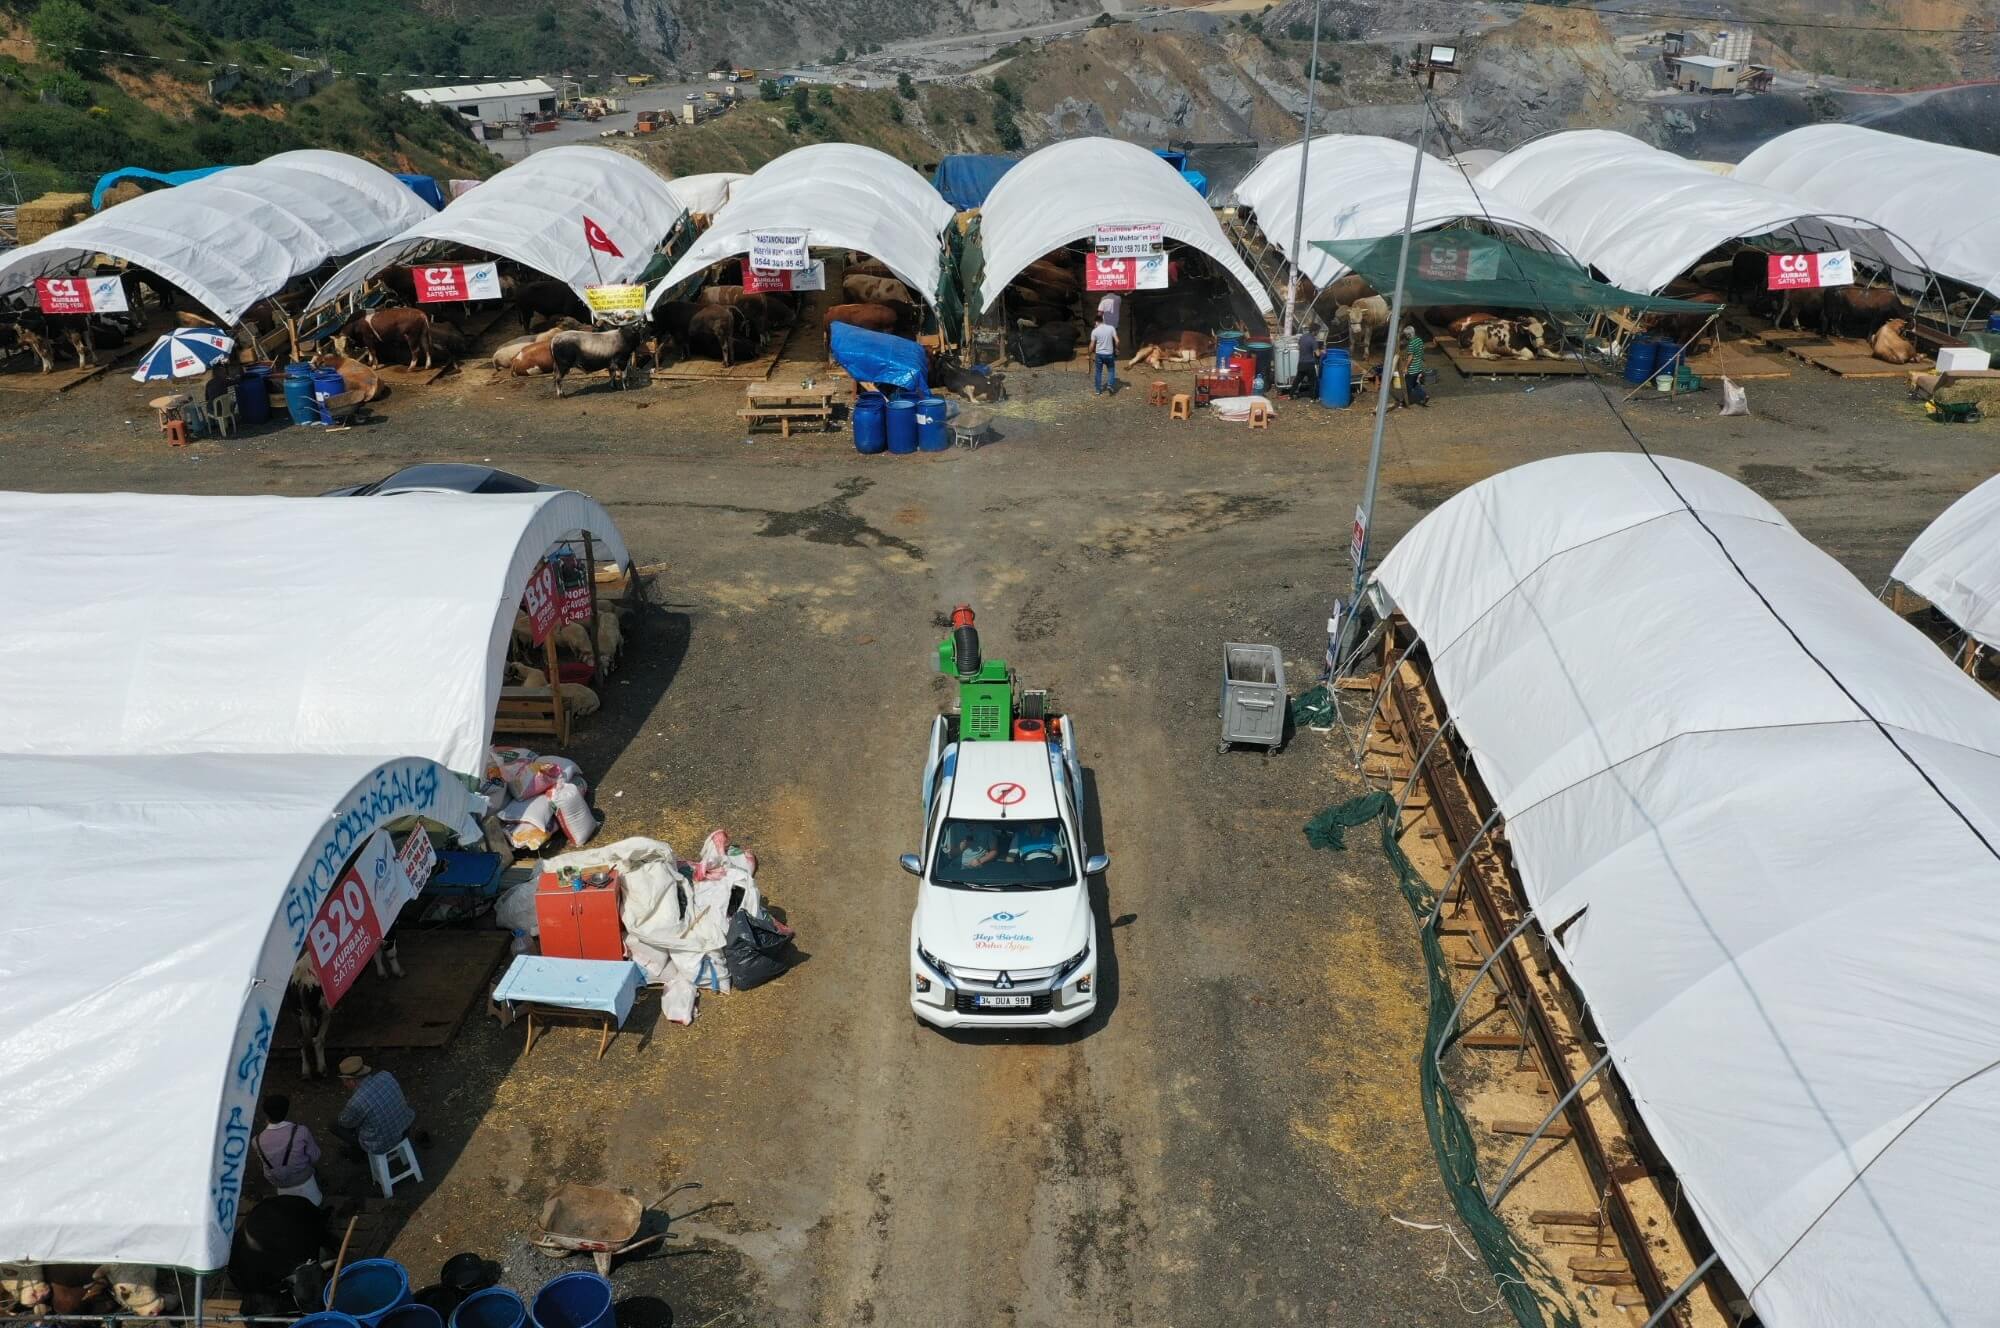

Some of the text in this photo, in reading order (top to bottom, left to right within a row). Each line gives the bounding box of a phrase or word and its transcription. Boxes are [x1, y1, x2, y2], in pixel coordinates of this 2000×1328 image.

[1096, 258, 1126, 272] C4
[1431, 248, 1458, 264] C5
[1780, 255, 1808, 272] C6
[424, 268, 454, 284] C2
[46, 280, 80, 296] C1
[526, 568, 552, 616] B19
[310, 880, 365, 968] B20
[332, 926, 366, 971] KURBAN
[333, 957, 355, 987] SATIŞ
[212, 1106, 248, 1234] SİNOP
